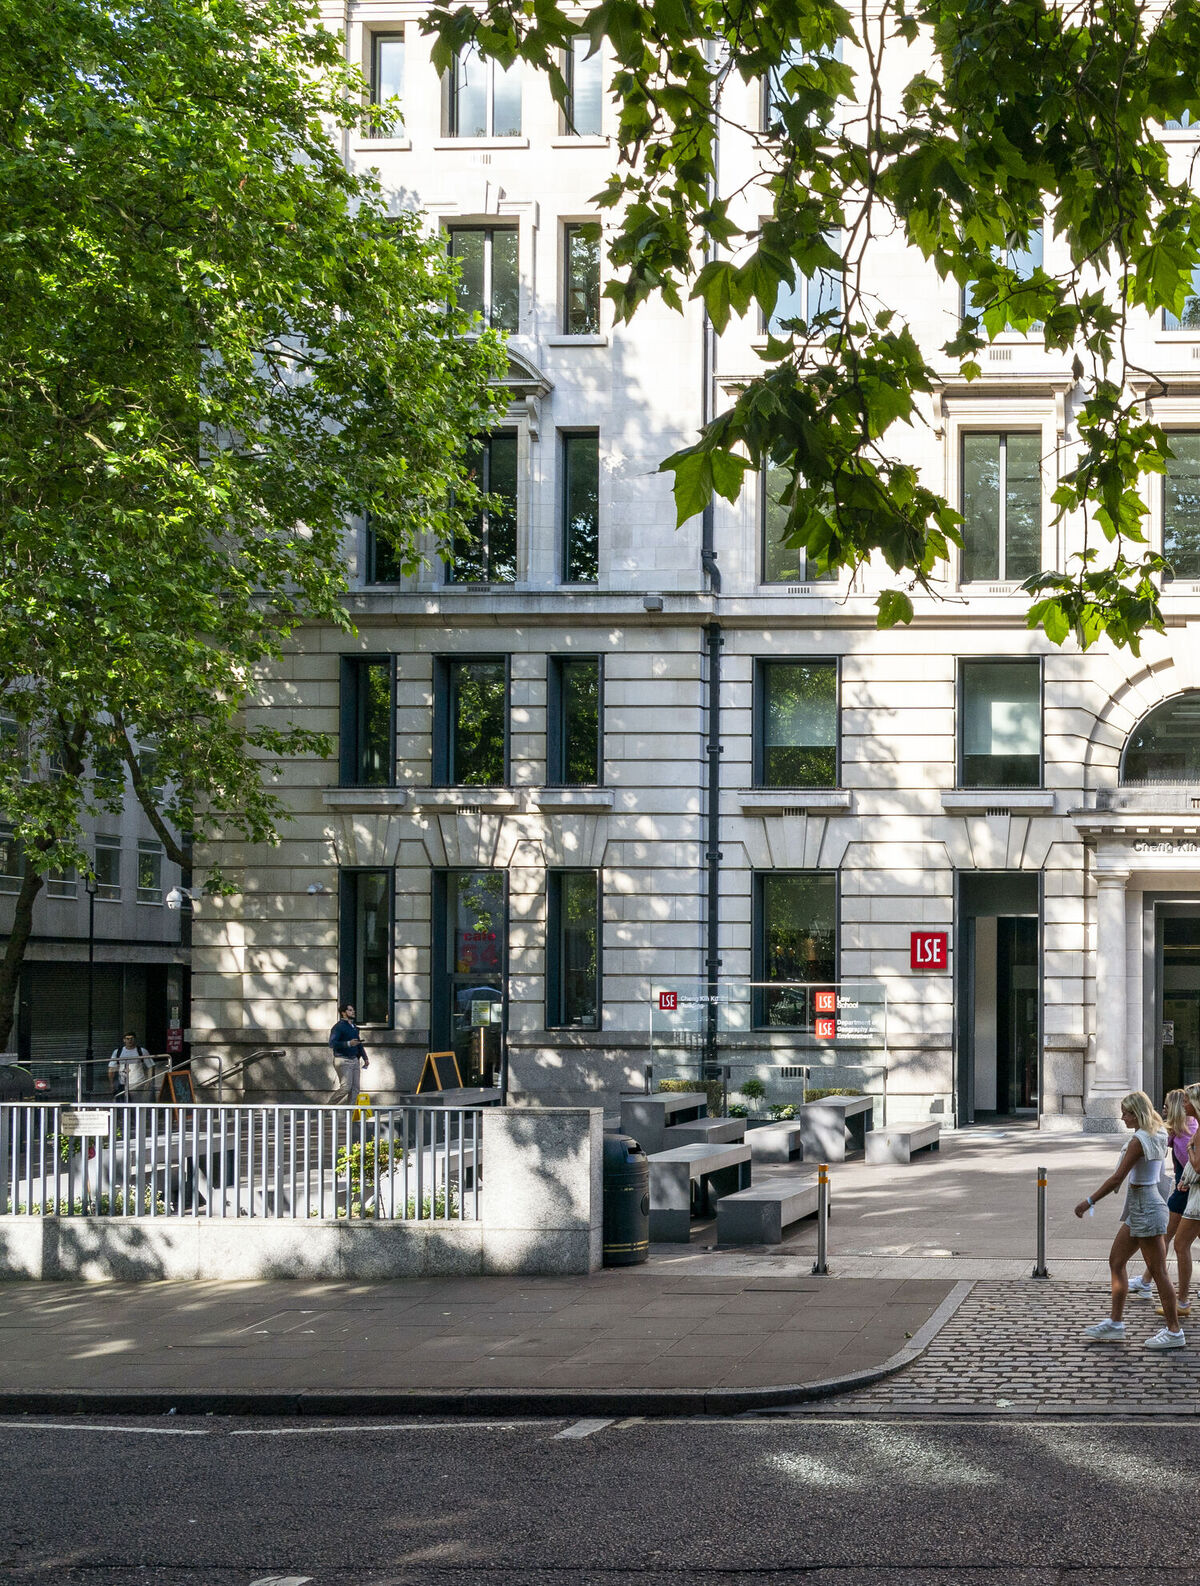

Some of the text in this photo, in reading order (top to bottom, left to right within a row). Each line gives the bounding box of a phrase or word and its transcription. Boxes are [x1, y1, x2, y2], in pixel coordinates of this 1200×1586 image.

[1133, 838, 1174, 853] Cheng
[1177, 838, 1198, 852] Kin
[462, 944, 498, 966] 54
[916, 938, 941, 963] LSE
[661, 994, 675, 1007] LSE
[819, 995, 832, 1009] LSE
[836, 994, 850, 1002] Law
[836, 1001, 858, 1009] School
[818, 1022, 832, 1036] LSE
[836, 1019, 871, 1027] Department
